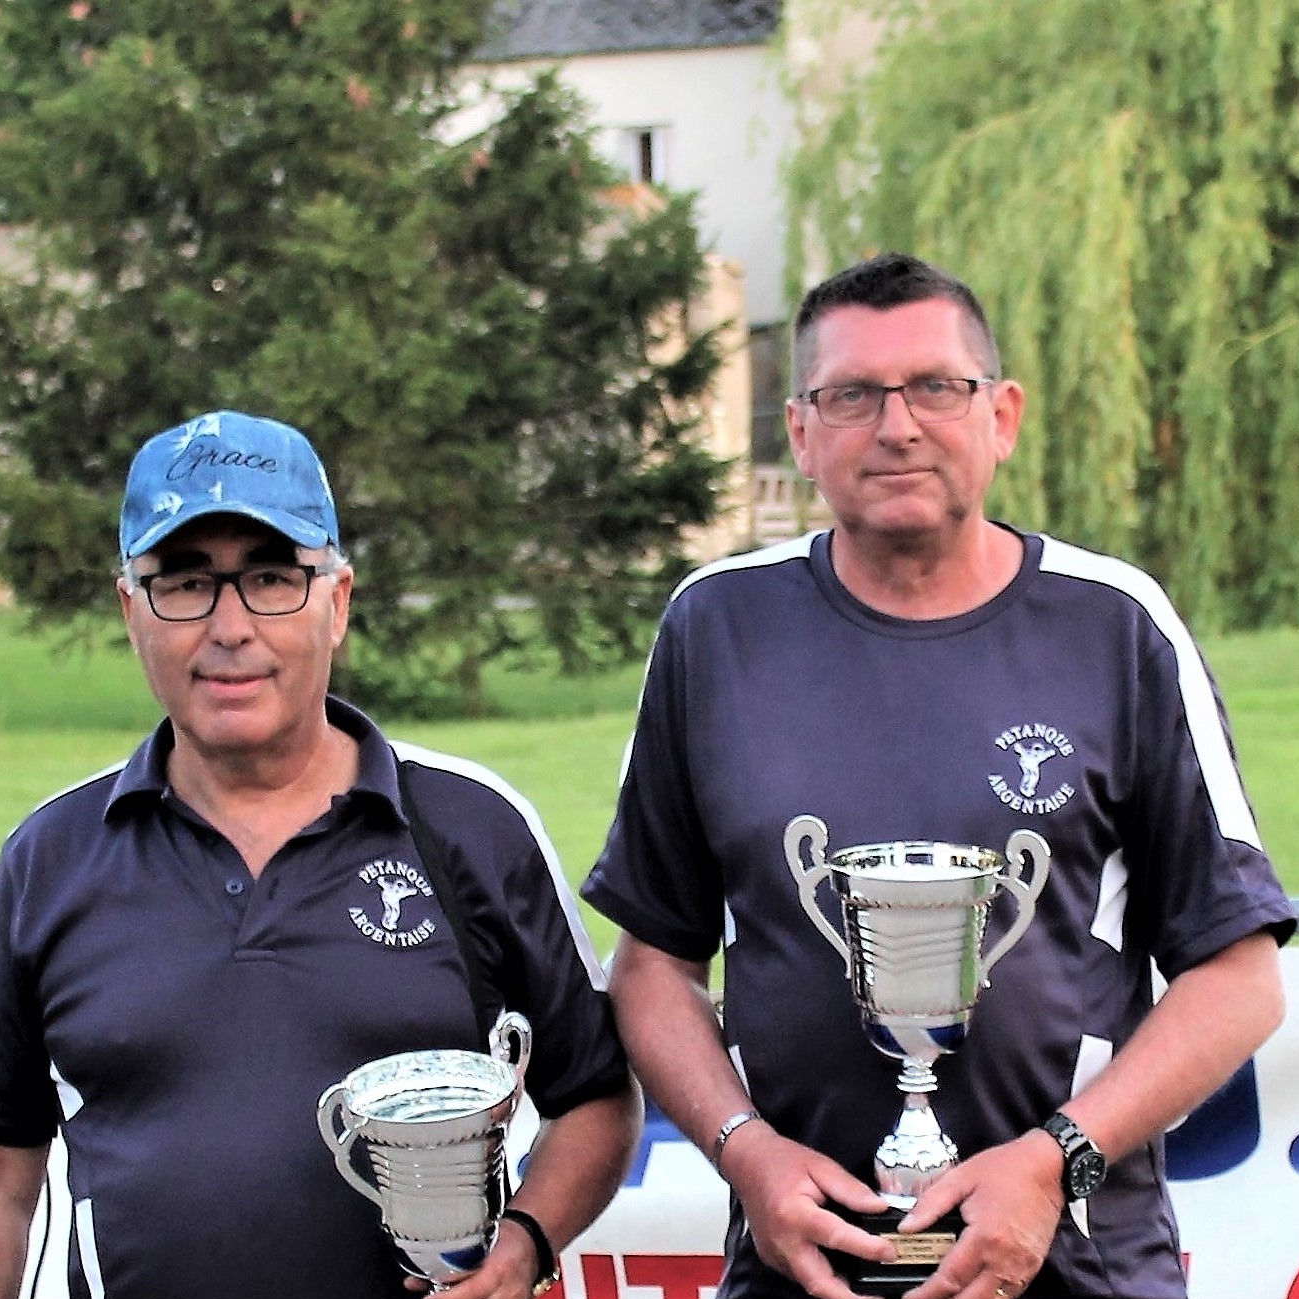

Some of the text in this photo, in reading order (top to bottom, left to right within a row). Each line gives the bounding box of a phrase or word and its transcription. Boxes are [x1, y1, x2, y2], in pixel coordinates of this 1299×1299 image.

[166, 436, 278, 481] Grace
[995, 723, 1075, 757] PETANQUE
[987, 774, 1076, 815] ARGENTAISE
[359, 860, 434, 897] PETANQUE
[347, 907, 437, 947] ARGENTAISE
